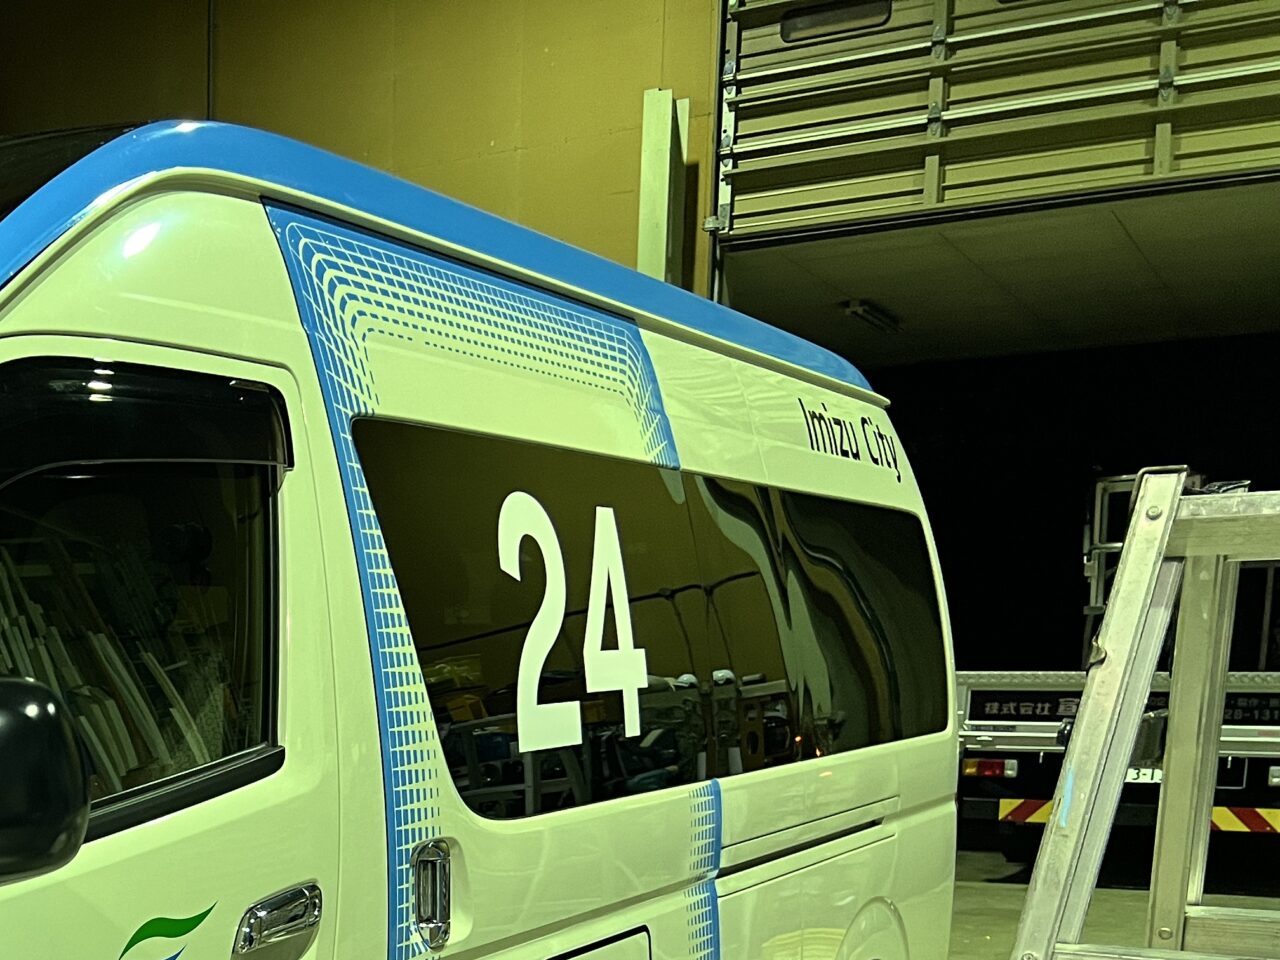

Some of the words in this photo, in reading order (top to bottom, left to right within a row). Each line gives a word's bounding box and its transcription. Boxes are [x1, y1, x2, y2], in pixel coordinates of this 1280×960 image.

[798, 397, 861, 461] Imizu
[861, 416, 901, 483] City
[498, 490, 648, 753] 24
